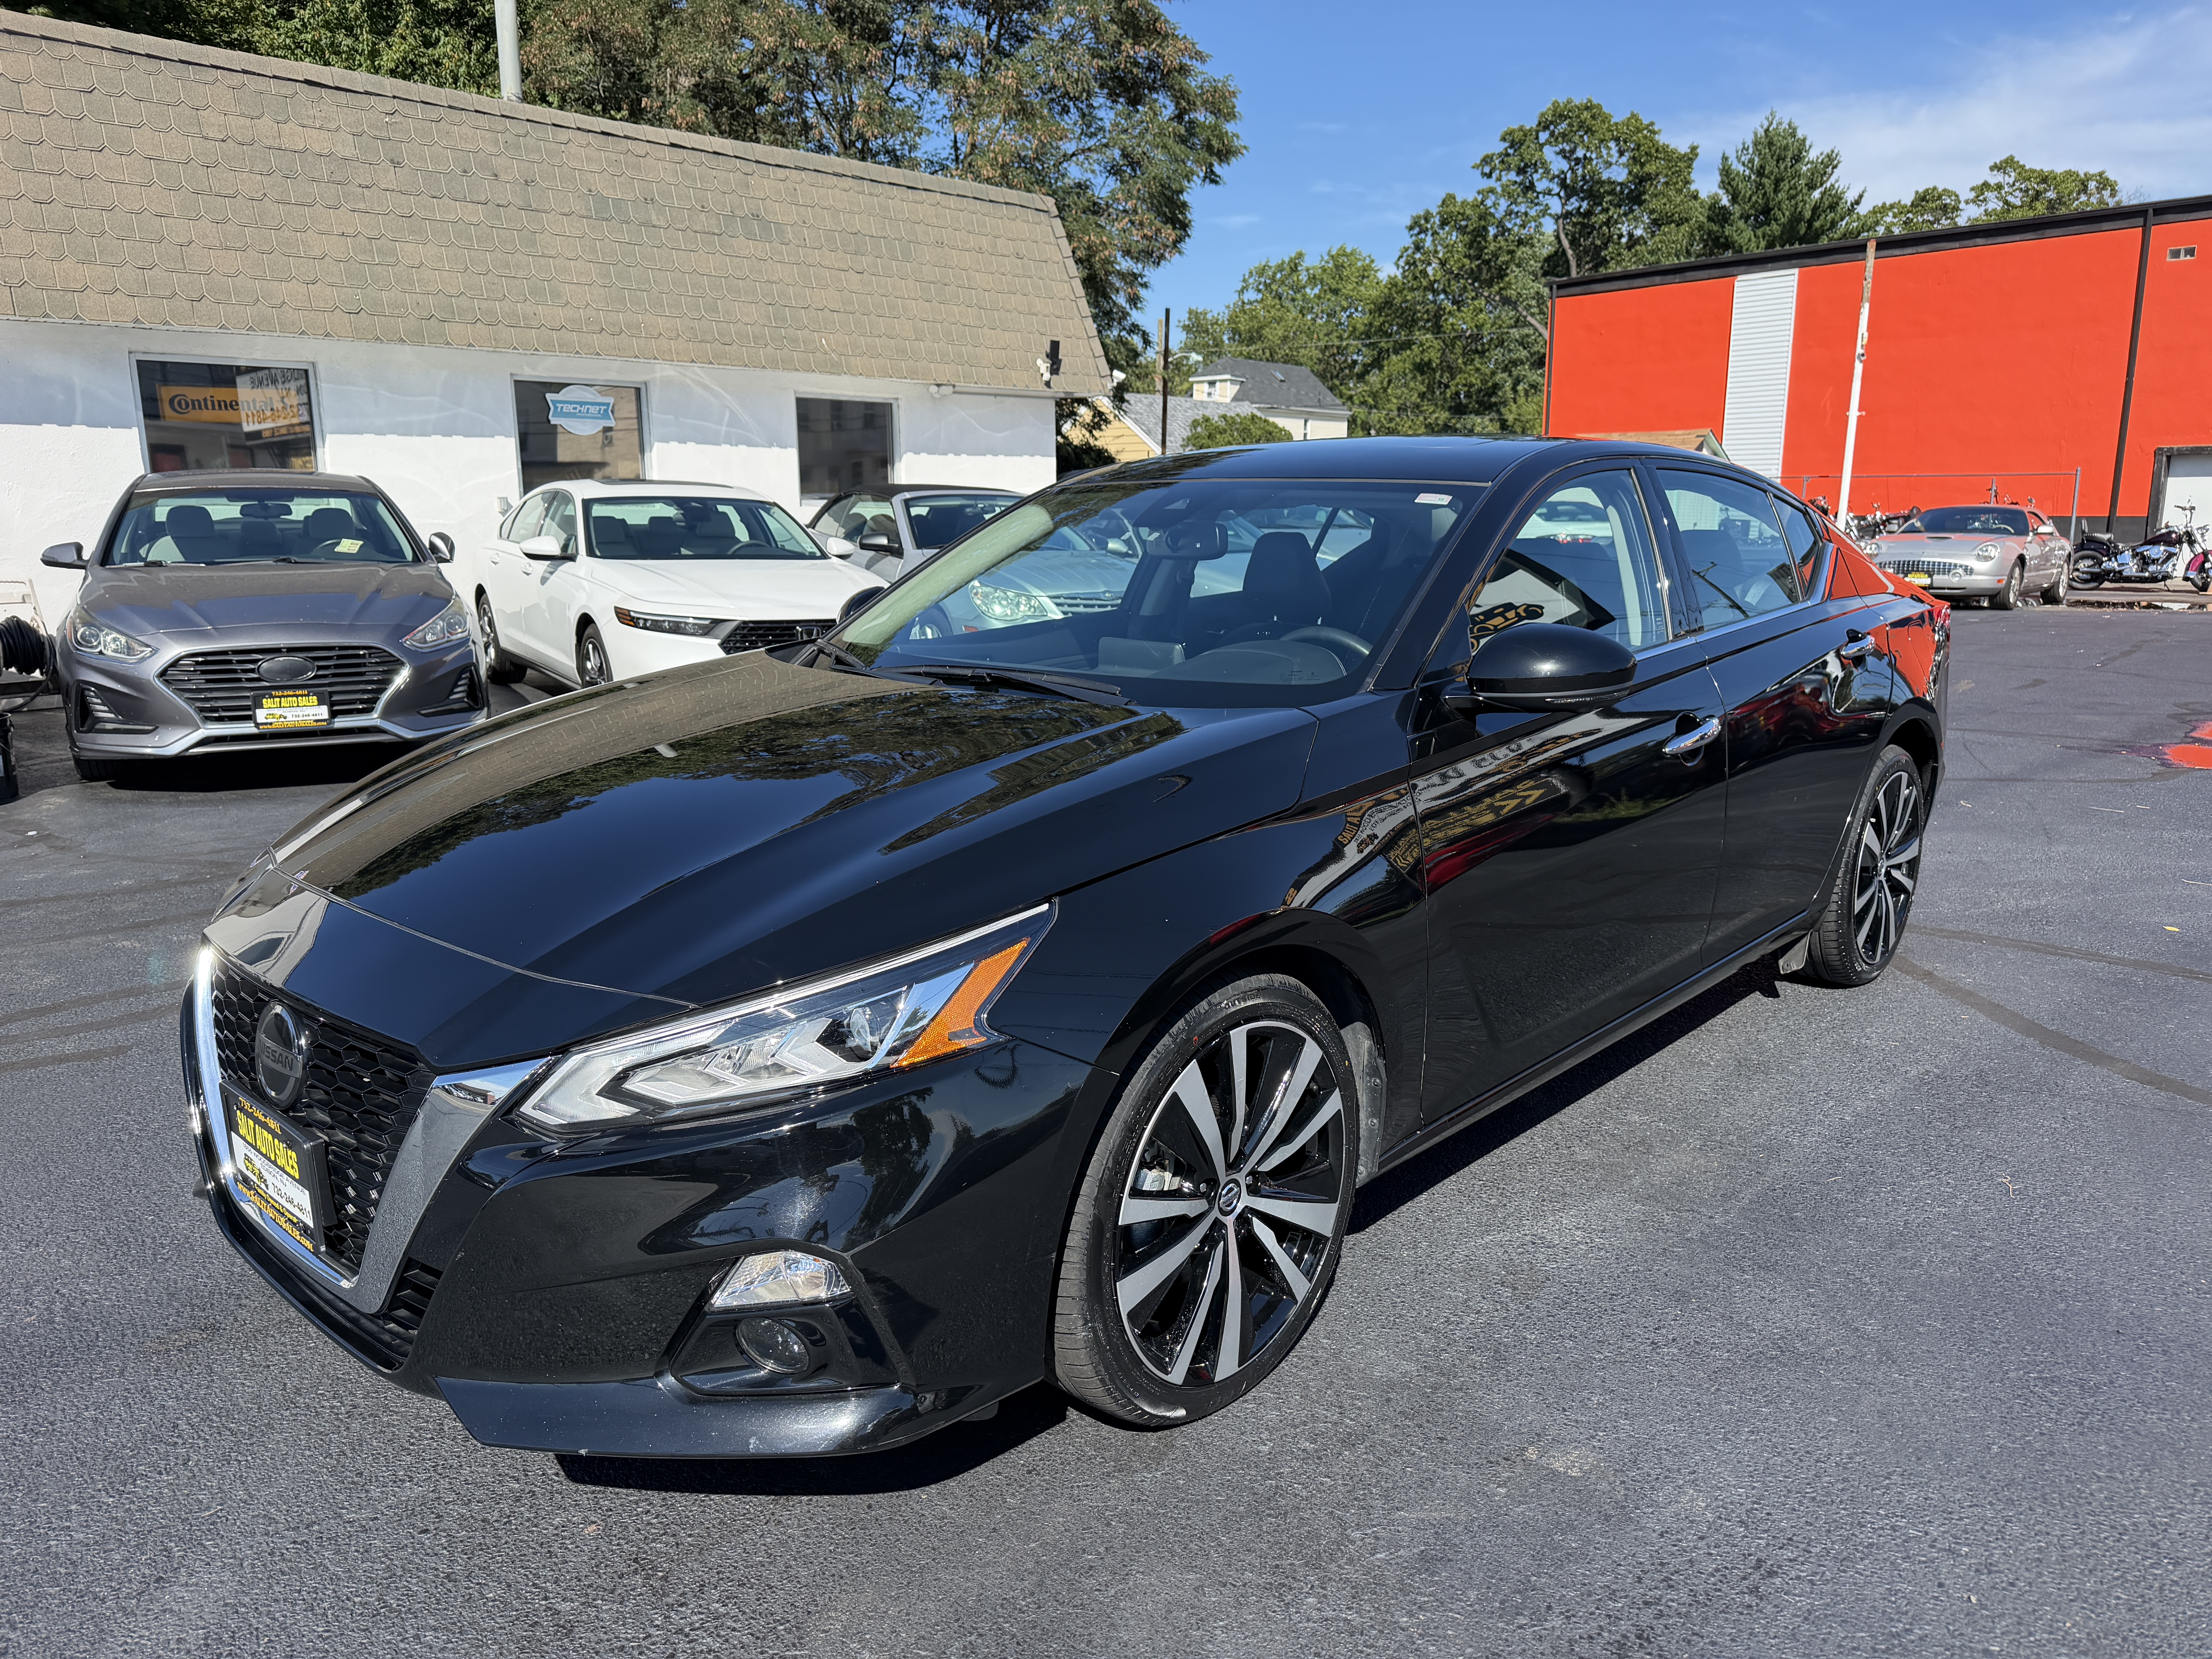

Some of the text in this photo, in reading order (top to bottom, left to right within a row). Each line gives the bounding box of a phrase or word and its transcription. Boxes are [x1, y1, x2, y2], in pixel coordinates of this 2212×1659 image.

[168, 394, 275, 414] Continental
[556, 404, 607, 414] TECHNET
[263, 696, 318, 708] SALIT AUTO SALES
[259, 1038, 294, 1071] NISSAN
[239, 1097, 282, 1134] 732-246-4811
[237, 1110, 299, 1179] SALIT AUTO SALES
[253, 1152, 285, 1180] WOODBRIDGE
[286, 1176, 306, 1195] AVENUE
[280, 1178, 287, 1187] NJ
[272, 1182, 311, 1221] 732-246-4811
